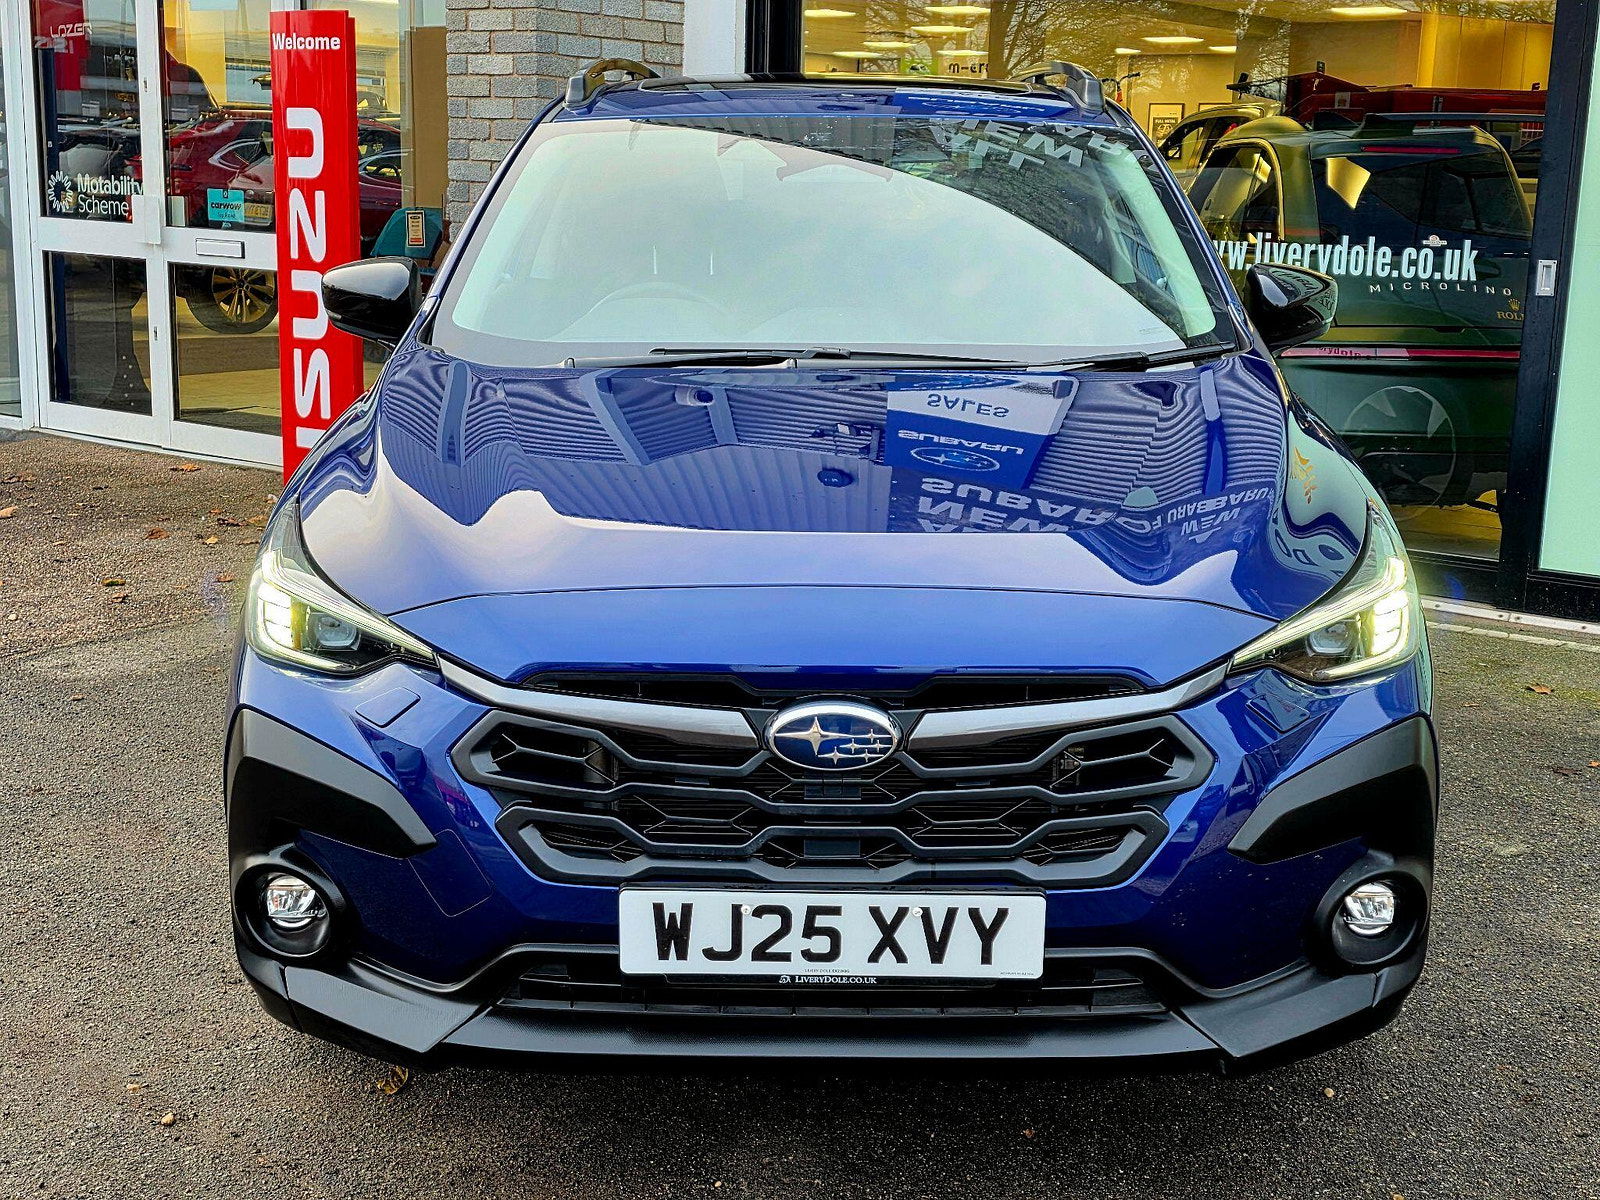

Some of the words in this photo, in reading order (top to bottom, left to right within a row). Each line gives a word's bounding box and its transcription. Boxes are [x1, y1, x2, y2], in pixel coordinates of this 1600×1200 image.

[272, 32, 341, 50] Welcome
[77, 173, 144, 196] Motability
[78, 194, 129, 216] Scheme
[210, 202, 242, 211] carwow
[285, 107, 332, 450] ISUZU
[1369, 281, 1512, 296] MICROLINO
[652, 902, 843, 963] WJ25
[867, 905, 1010, 965] XVY
